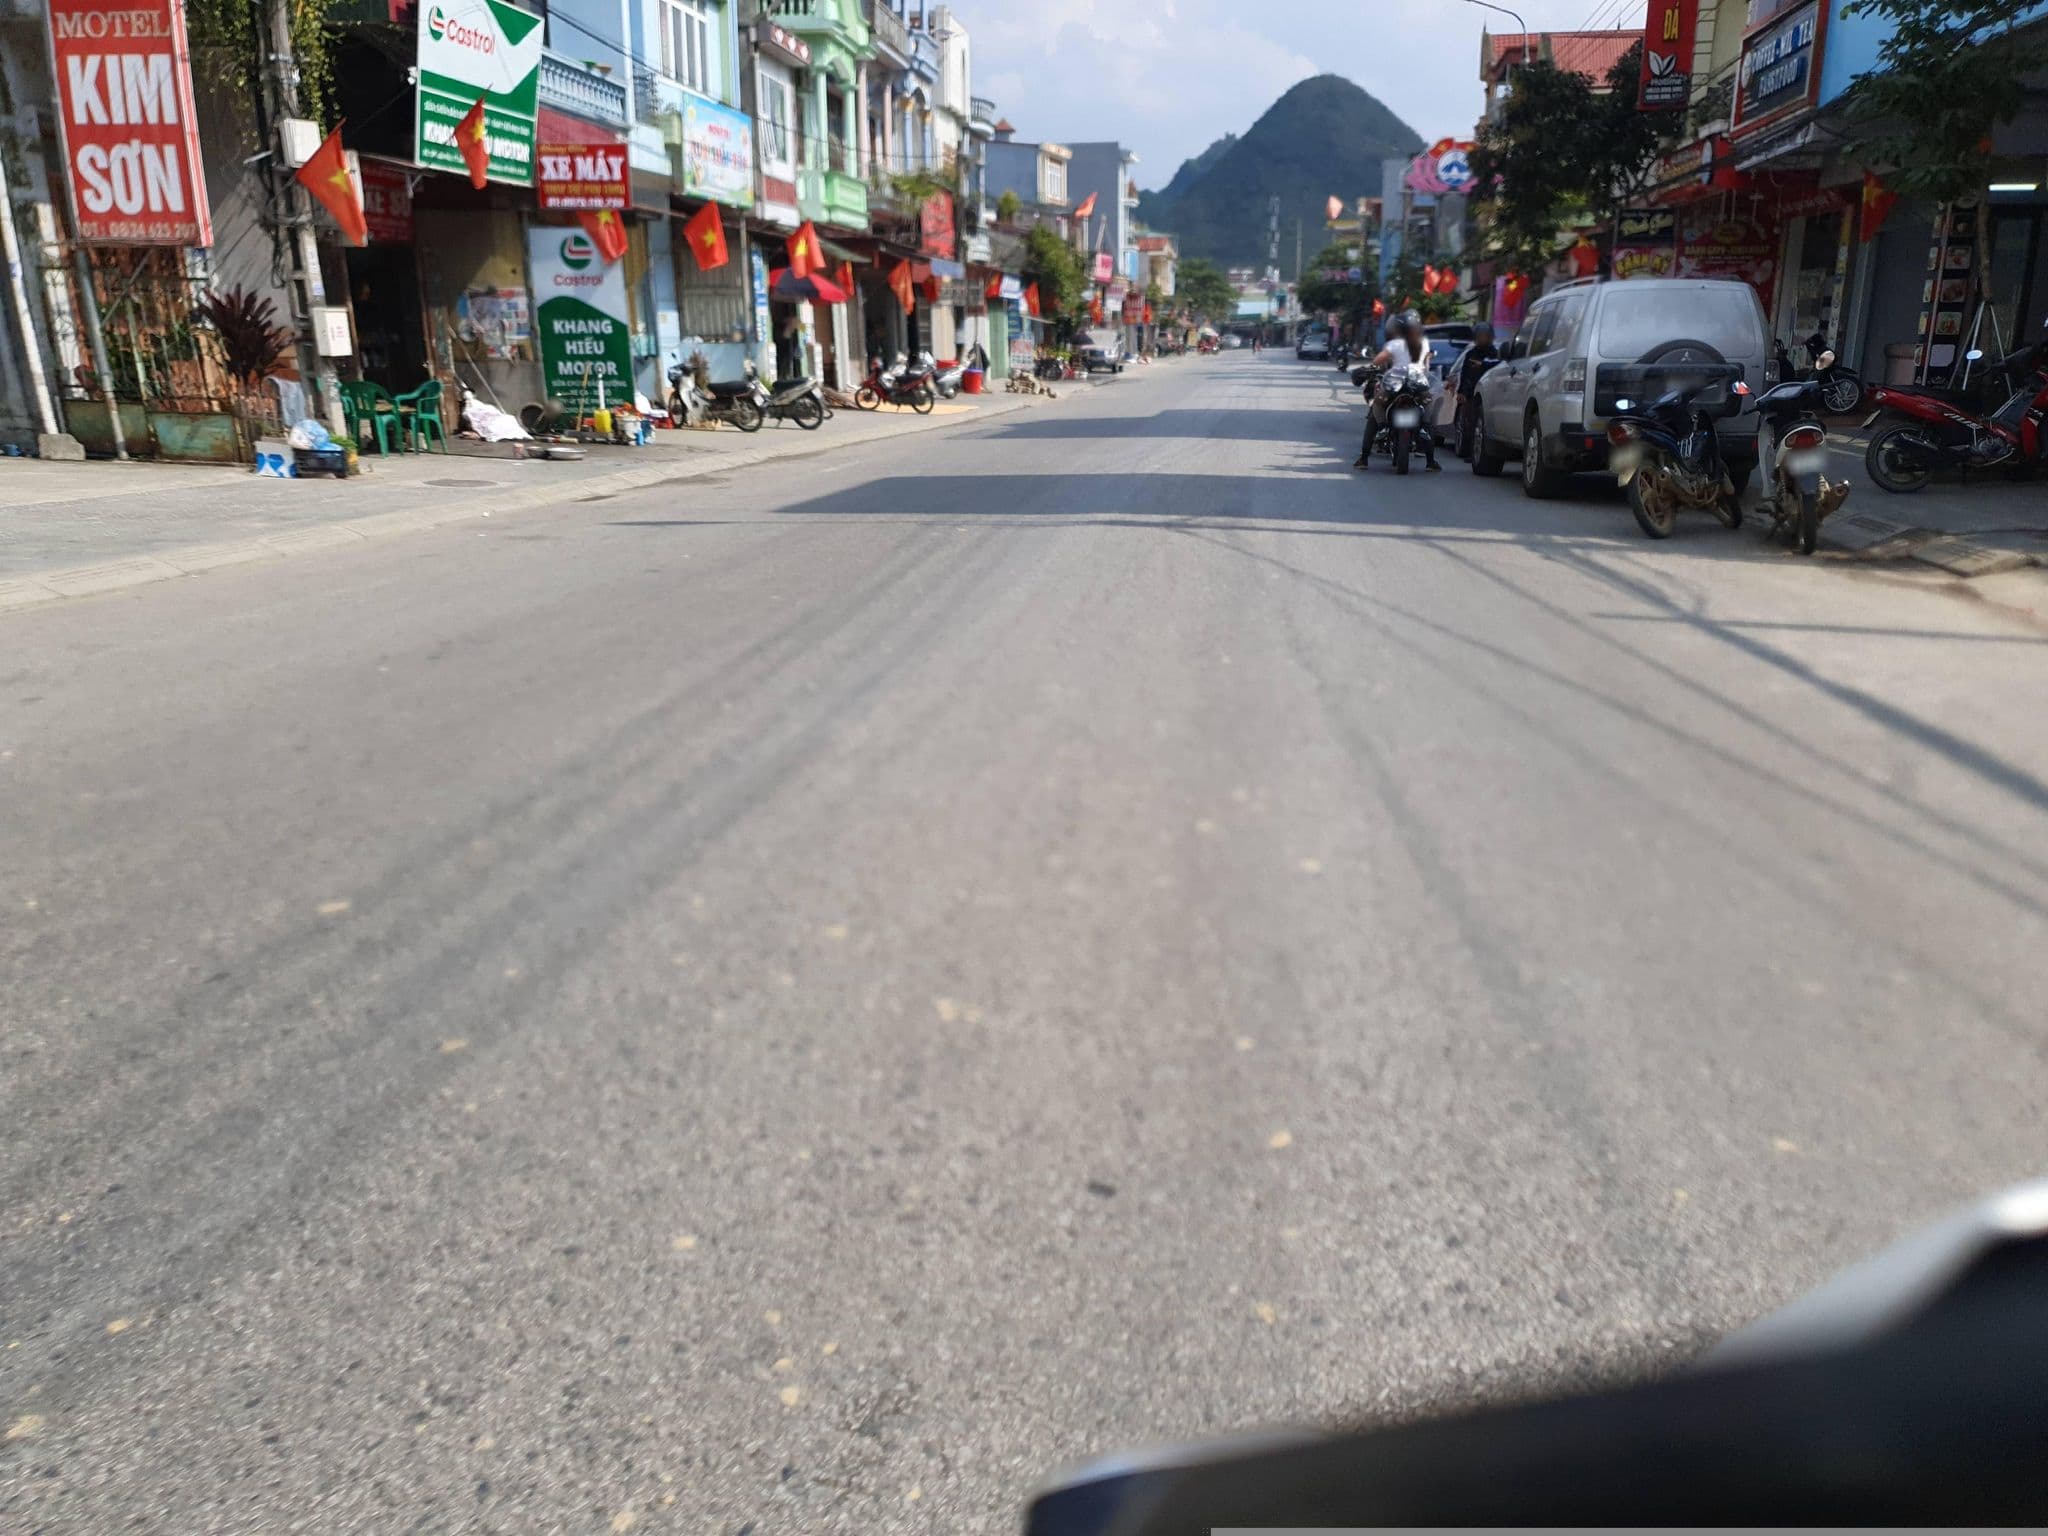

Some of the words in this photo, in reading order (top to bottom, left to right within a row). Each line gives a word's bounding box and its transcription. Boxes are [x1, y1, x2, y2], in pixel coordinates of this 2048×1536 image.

[54, 10, 171, 39] MOTEL
[447, 19, 496, 55] Castrol
[66, 53, 179, 125] KIM
[76, 138, 185, 215] SƠN
[540, 155, 573, 181] XE
[575, 149, 625, 181] MÁY
[554, 273, 604, 287] Castrol
[553, 320, 613, 334] KHANG
[565, 336, 605, 355] HIẾU
[558, 361, 618, 375] MOTOR
